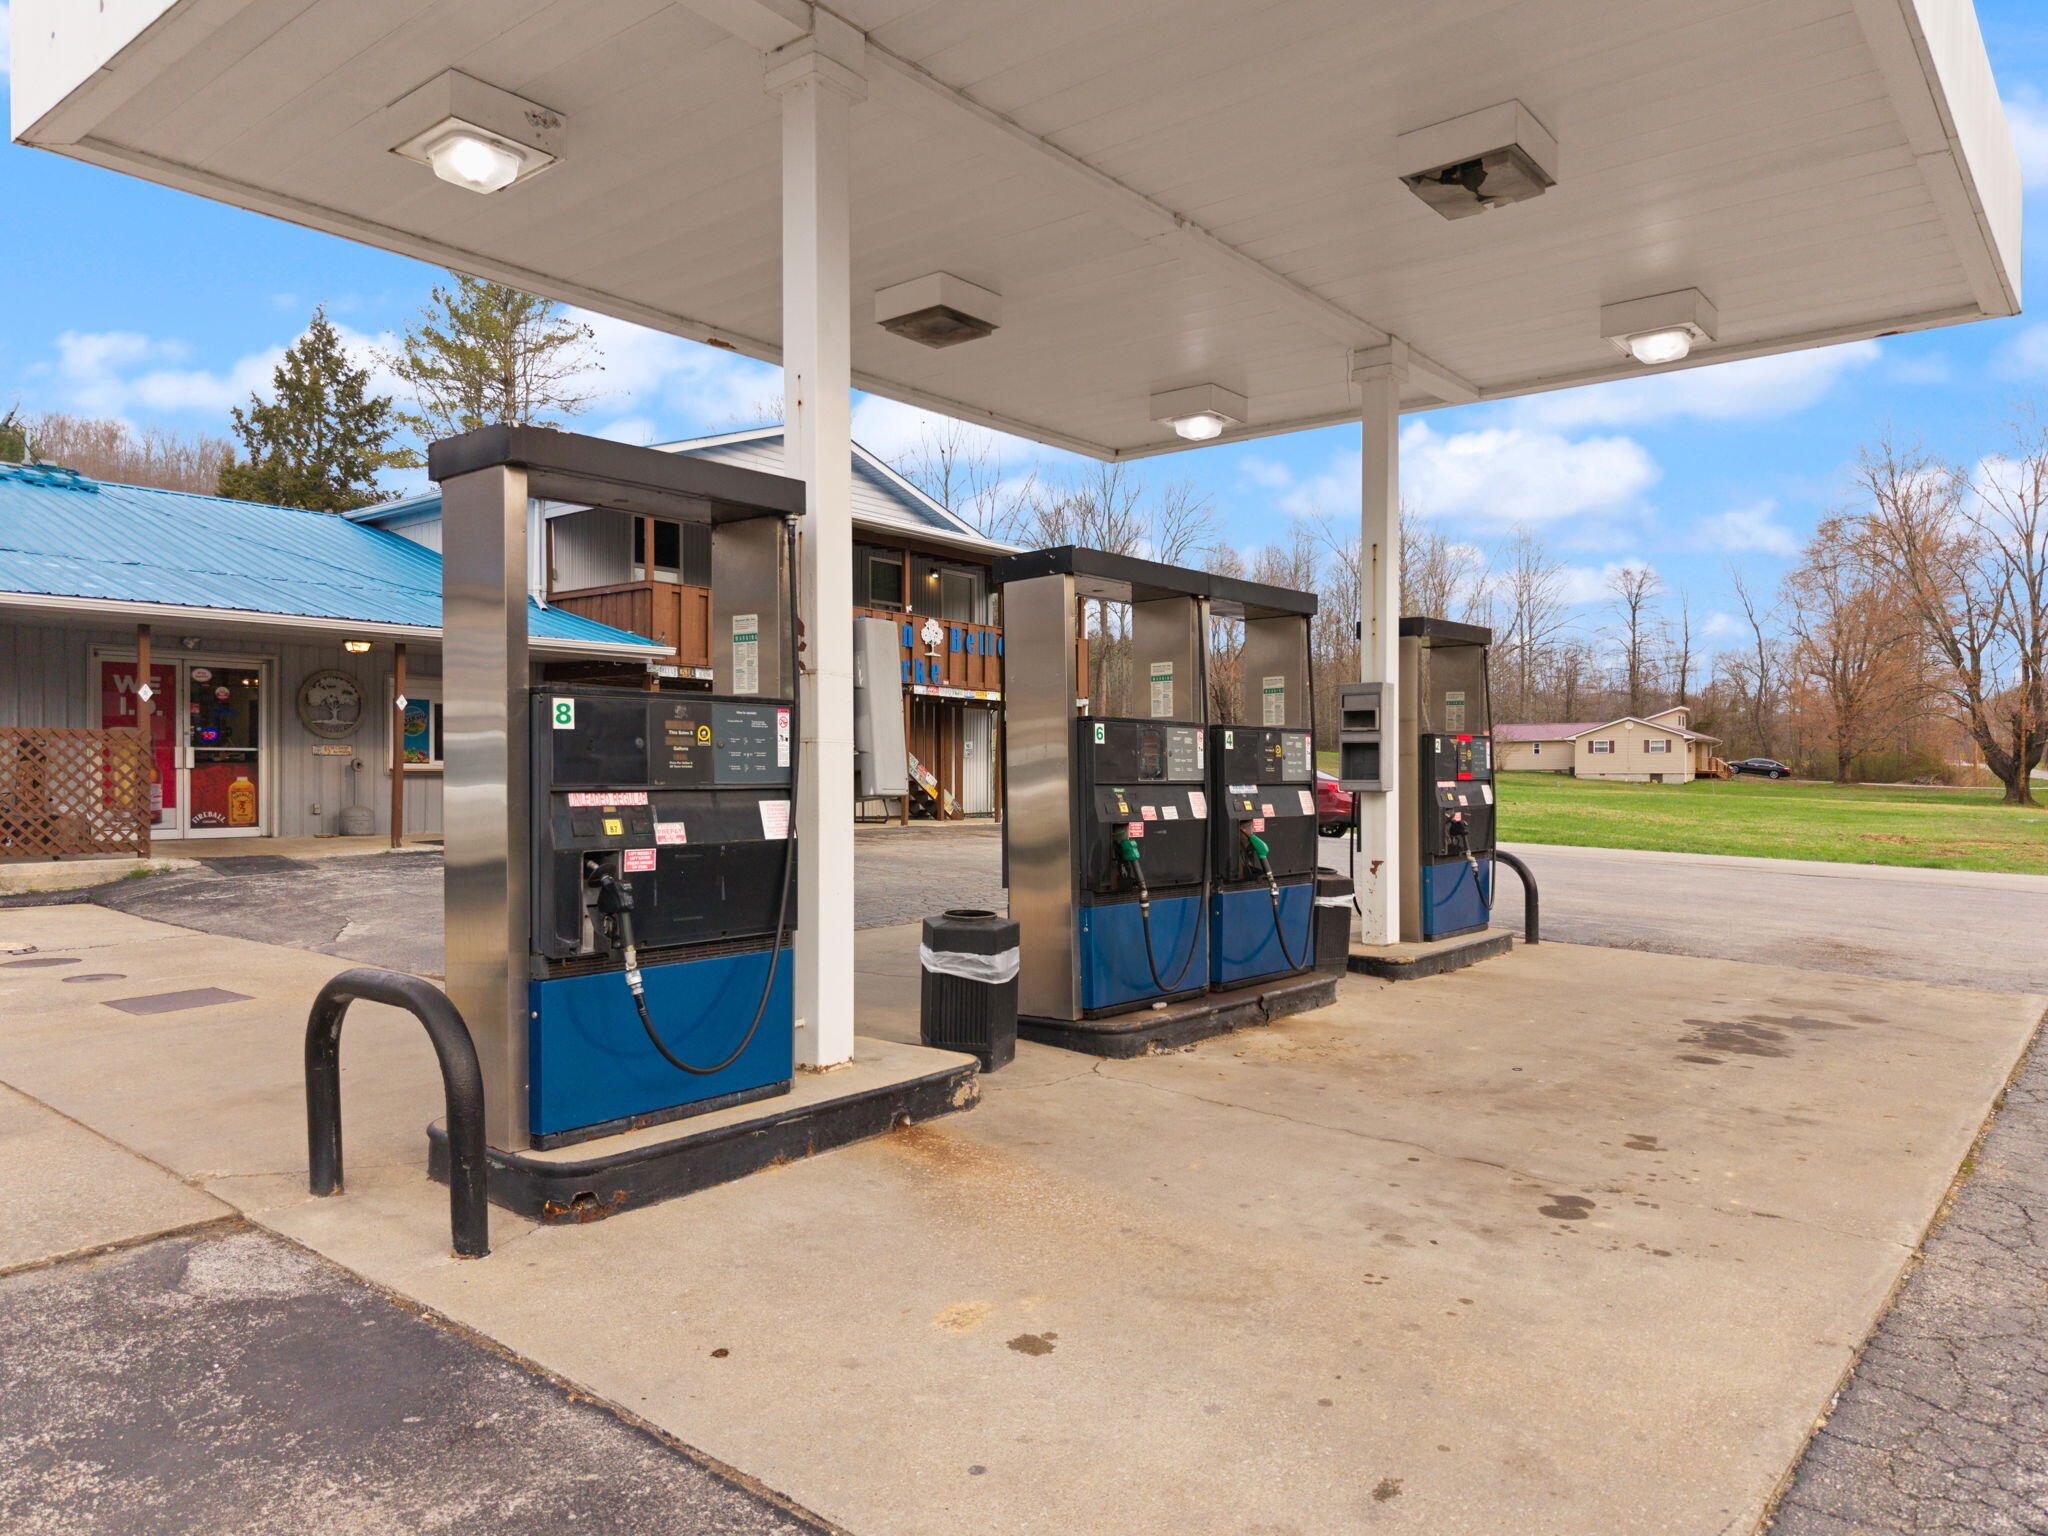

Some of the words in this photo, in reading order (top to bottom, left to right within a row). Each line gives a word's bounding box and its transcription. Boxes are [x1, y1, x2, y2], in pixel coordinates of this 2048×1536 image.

[113, 674, 162, 694] WE
[556, 703, 572, 724] 8
[1096, 727, 1104, 741] 6
[1226, 734, 1233, 746] 4
[1436, 740, 1440, 751] 2
[569, 792, 611, 806] UNLEADED
[613, 791, 647, 806] REGULAR
[192, 811, 226, 824] FIREBALL
[609, 825, 618, 833] 87
